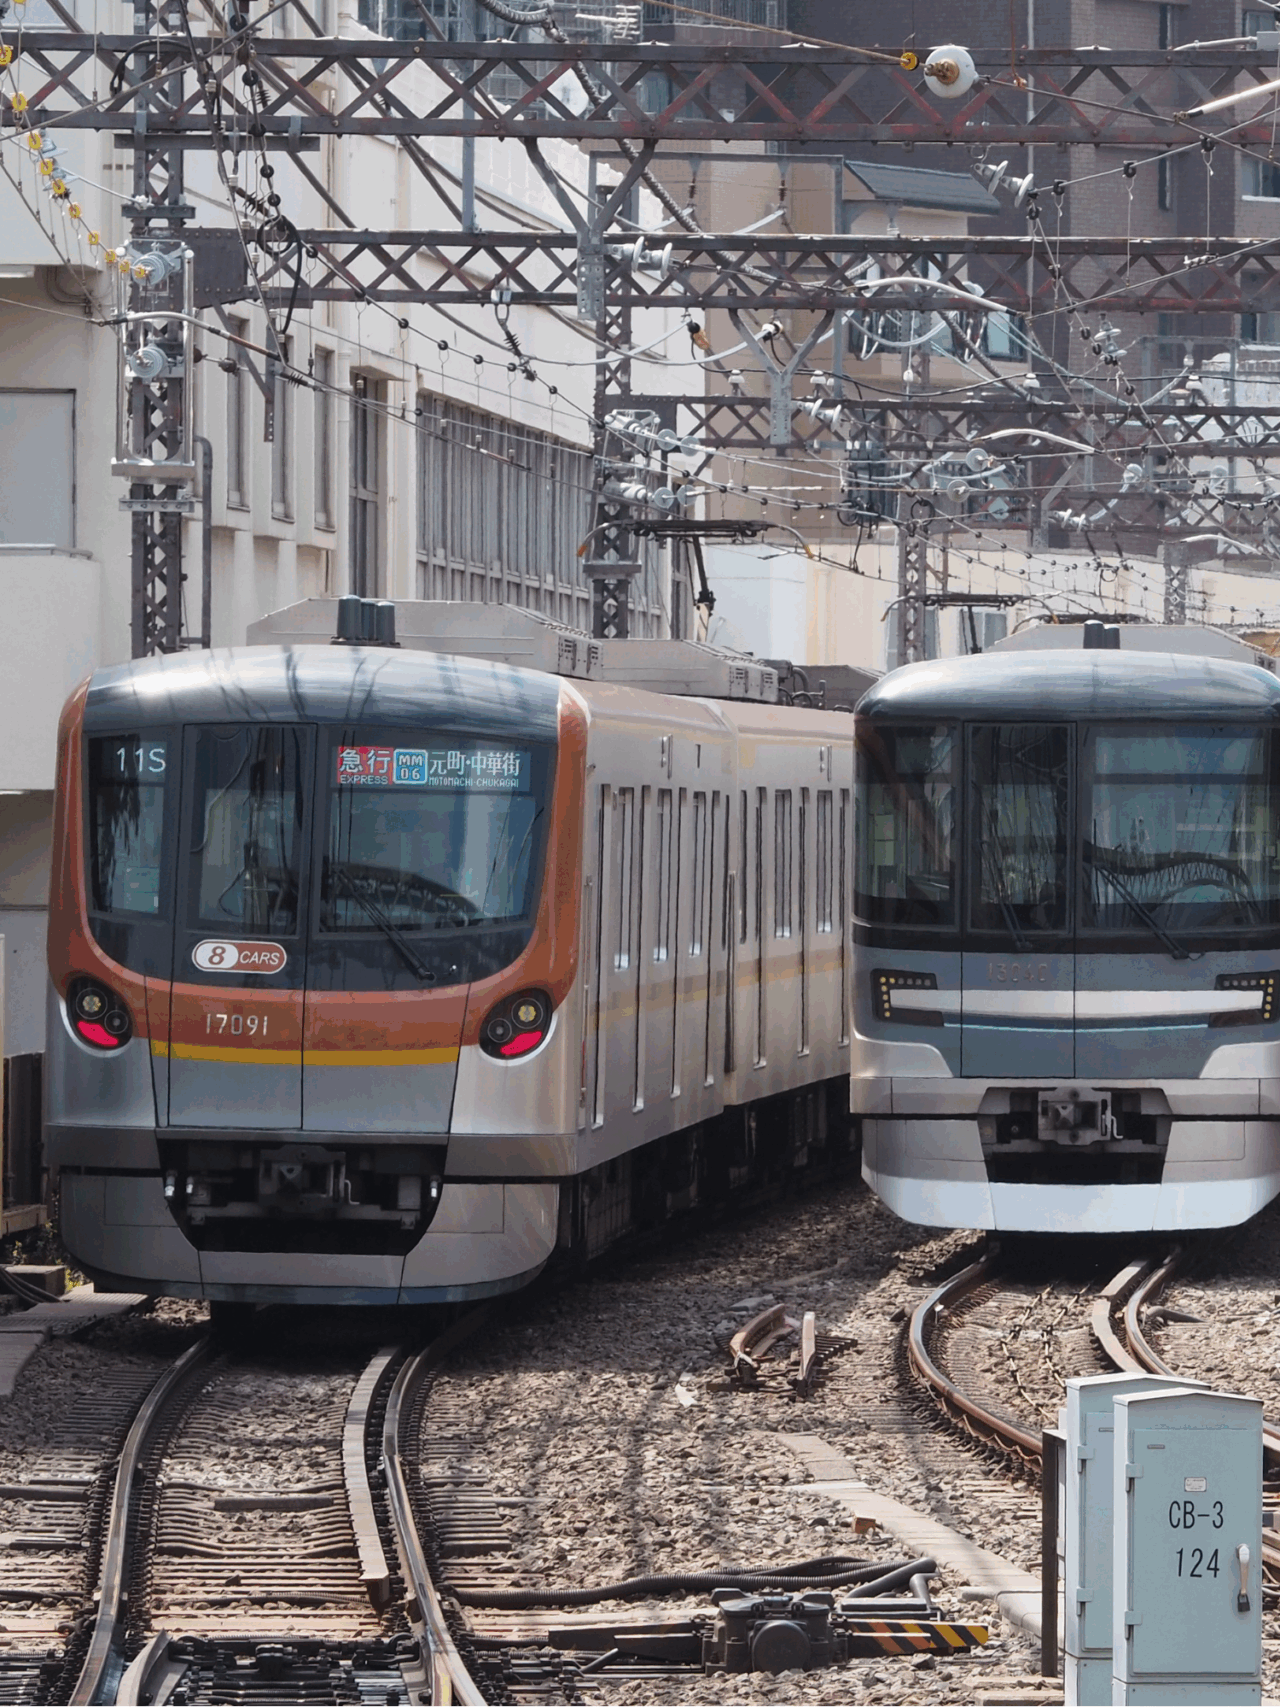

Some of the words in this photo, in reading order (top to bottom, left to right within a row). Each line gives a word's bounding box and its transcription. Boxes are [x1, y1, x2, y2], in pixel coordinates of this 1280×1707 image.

[116, 747, 166, 773] 11S
[338, 749, 391, 773] 急行
[398, 754, 423, 767] MM
[340, 775, 388, 785] EXPRESS
[401, 768, 420, 780] 06
[208, 946, 226, 965] 8
[240, 951, 280, 965] CARS
[206, 1013, 268, 1036] 17091
[1169, 1501, 1224, 1529] CB-3
[1176, 1547, 1220, 1578] 124
